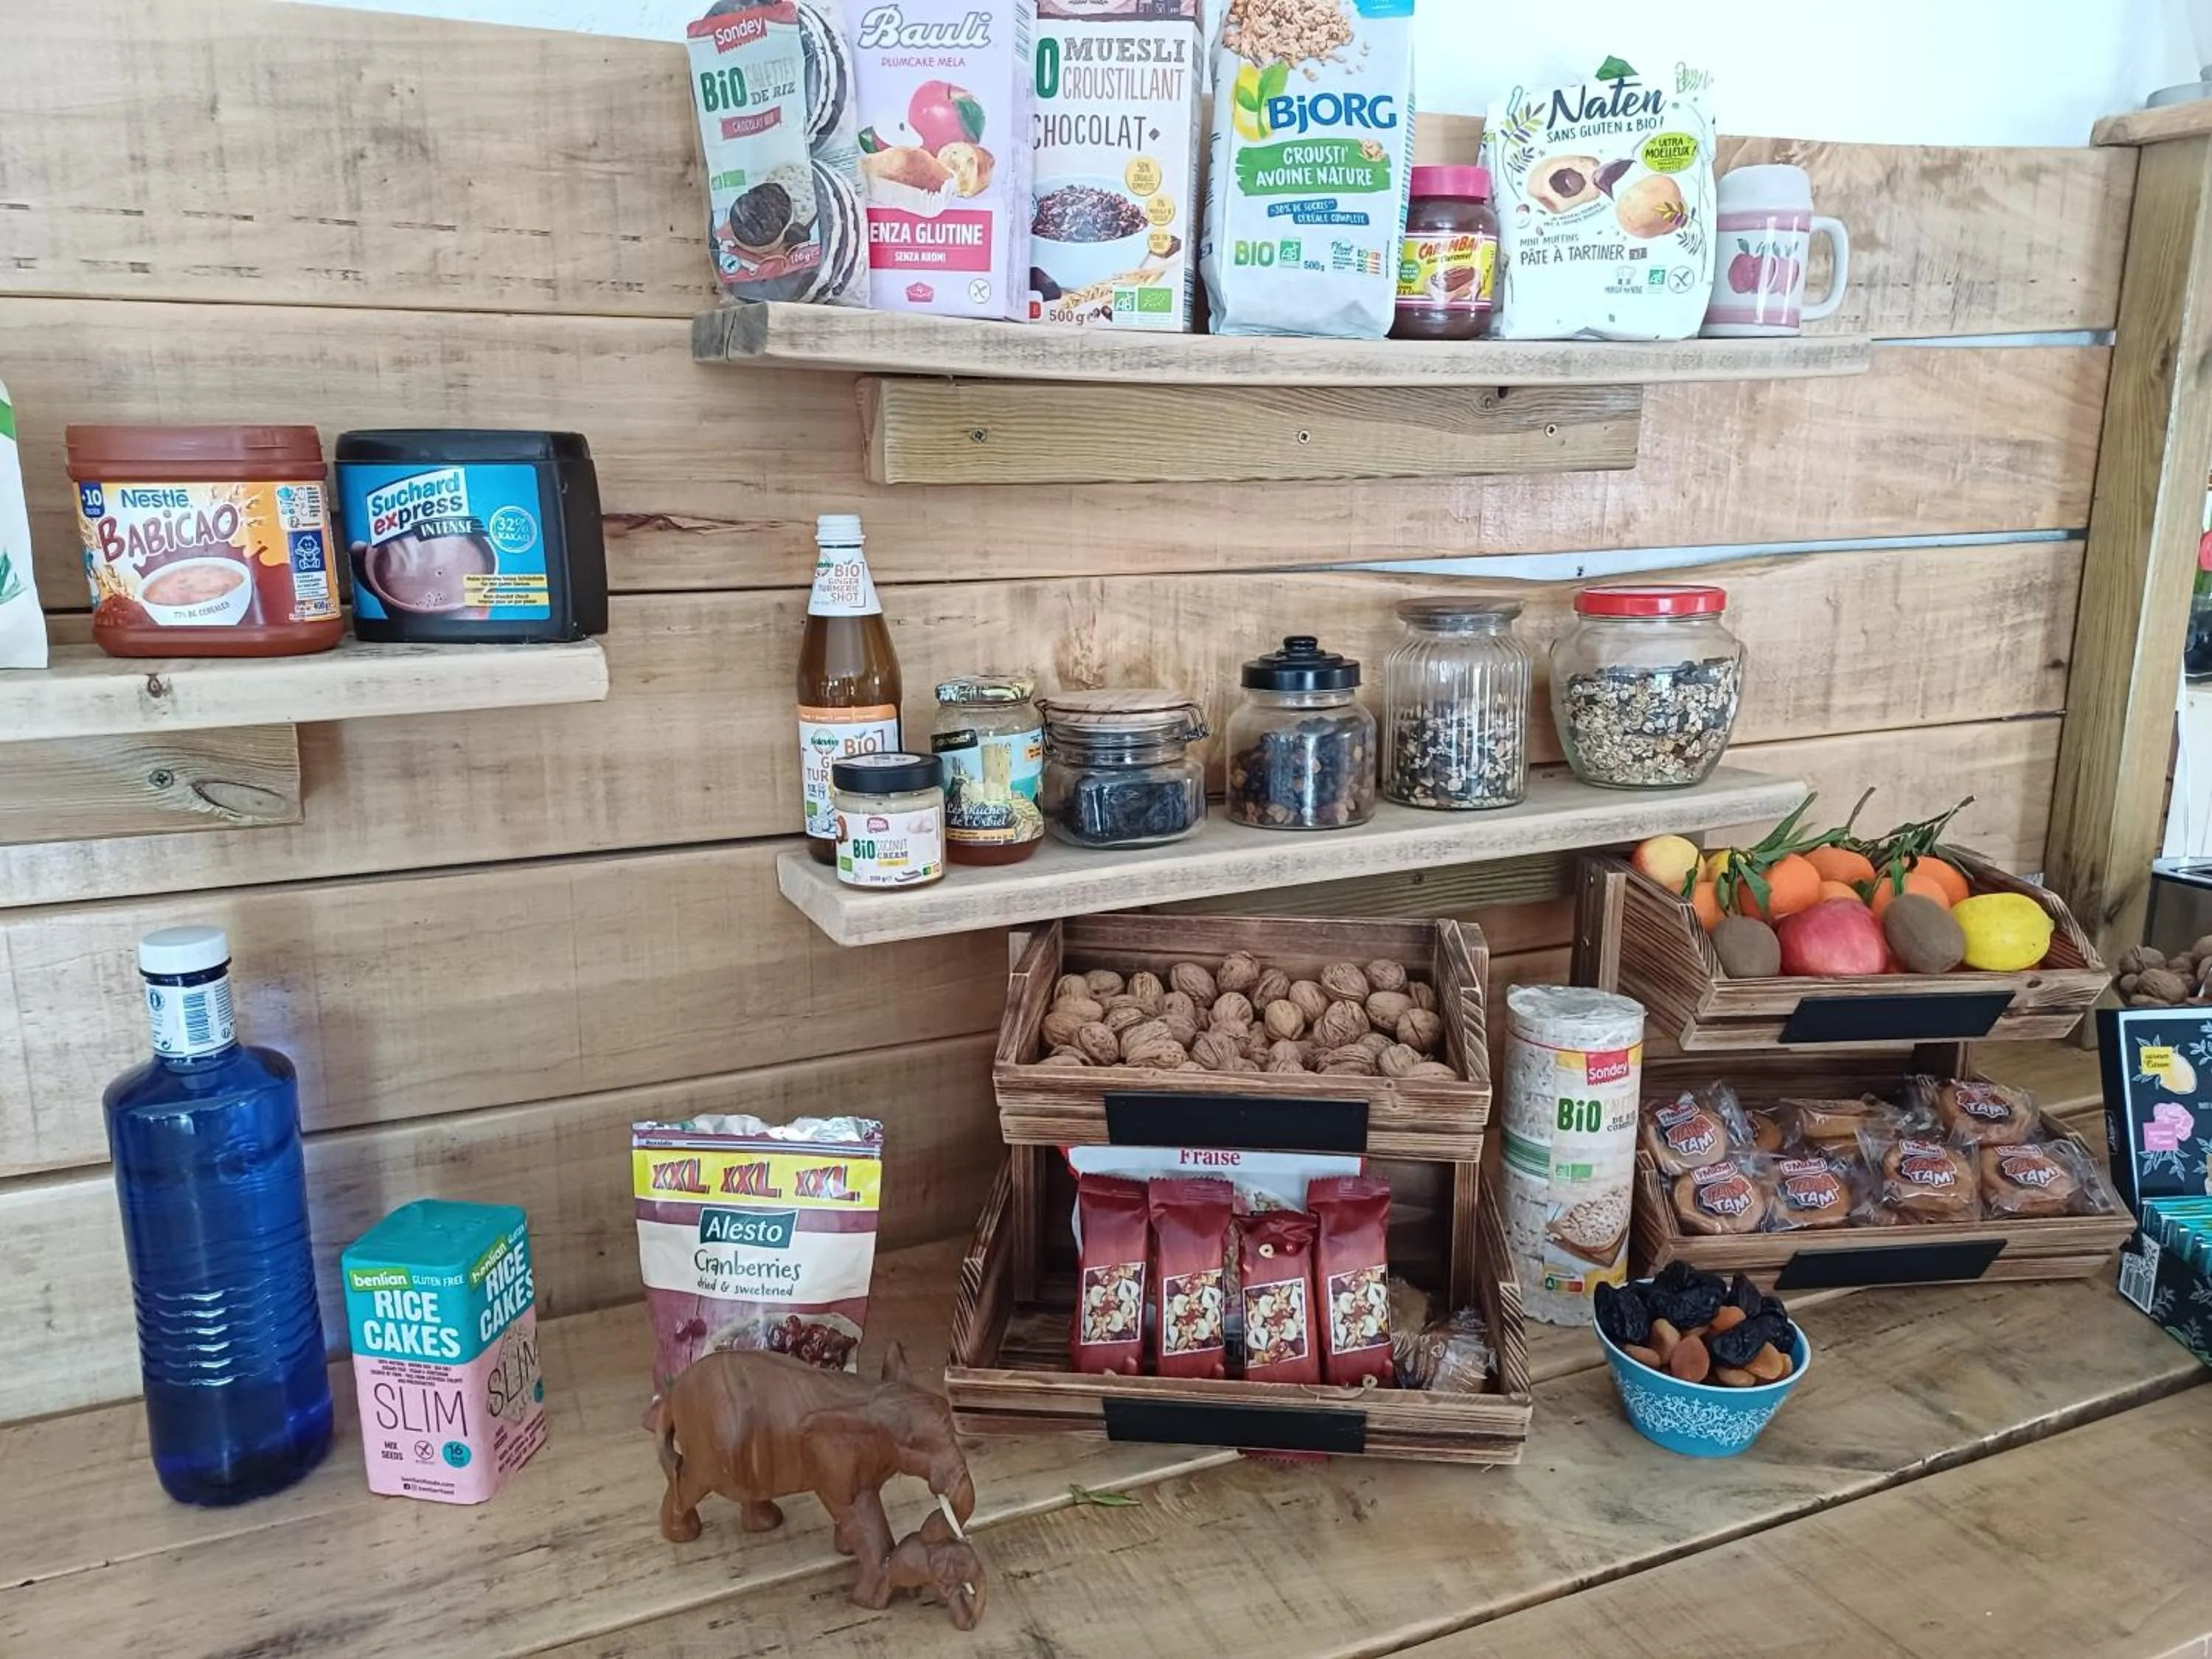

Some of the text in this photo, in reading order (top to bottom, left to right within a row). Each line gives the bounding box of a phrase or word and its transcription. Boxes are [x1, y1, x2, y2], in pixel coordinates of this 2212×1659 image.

[714, 17, 763, 46] Sondey
[858, 4, 992, 49] Bauli
[1064, 38, 1186, 63] MUESLI
[881, 58, 966, 67] PLUMCAKE MELA
[751, 82, 796, 105] DE RIZ
[1062, 66, 1185, 101] CROUSTILLANT
[1547, 77, 1666, 130] Naten
[1547, 128, 1576, 143] SANS
[1581, 121, 1623, 137] GLUTEN
[1636, 117, 1656, 132] BIO
[1256, 168, 1374, 187] AVOINE NATURE
[870, 222, 984, 245] ENZA GLUTINE
[1520, 234, 1579, 246] MINI MUFFINS
[894, 251, 919, 262] SENZA
[1234, 240, 1275, 267] BIO
[1520, 248, 1548, 266] PÂTE
[1554, 245, 1563, 262] À
[1568, 244, 1625, 261] TARTINER
[1049, 310, 1074, 322] 500
[372, 471, 461, 516] Suchard
[374, 495, 463, 536] express
[421, 520, 473, 537] INTENSE
[831, 592, 859, 602] SHOT
[1588, 1062, 1627, 1080] Sondey
[1966, 1103, 2006, 1116] TAM
[1679, 1132, 1714, 1152] TAM
[1180, 1150, 1241, 1166] Fraise
[1911, 1170, 1951, 1185] TAM
[2017, 1167, 2056, 1184] TAM
[1713, 1194, 1750, 1213] TAM
[1796, 1189, 1835, 1206] TAM
[706, 1215, 783, 1242] Alesto
[486, 1241, 526, 1302] RICE
[695, 1248, 801, 1281] Cranberries
[412, 1276, 441, 1287] GLUTEN
[443, 1274, 465, 1287] FREE
[698, 1277, 717, 1291] dried
[734, 1283, 794, 1296] sweetened
[374, 1290, 442, 1324] RICE
[481, 1268, 535, 1342] CAKES
[364, 1319, 462, 1358] CAKES
[374, 1382, 468, 1437] SLIM
[381, 1450, 403, 1461] SEEDS
